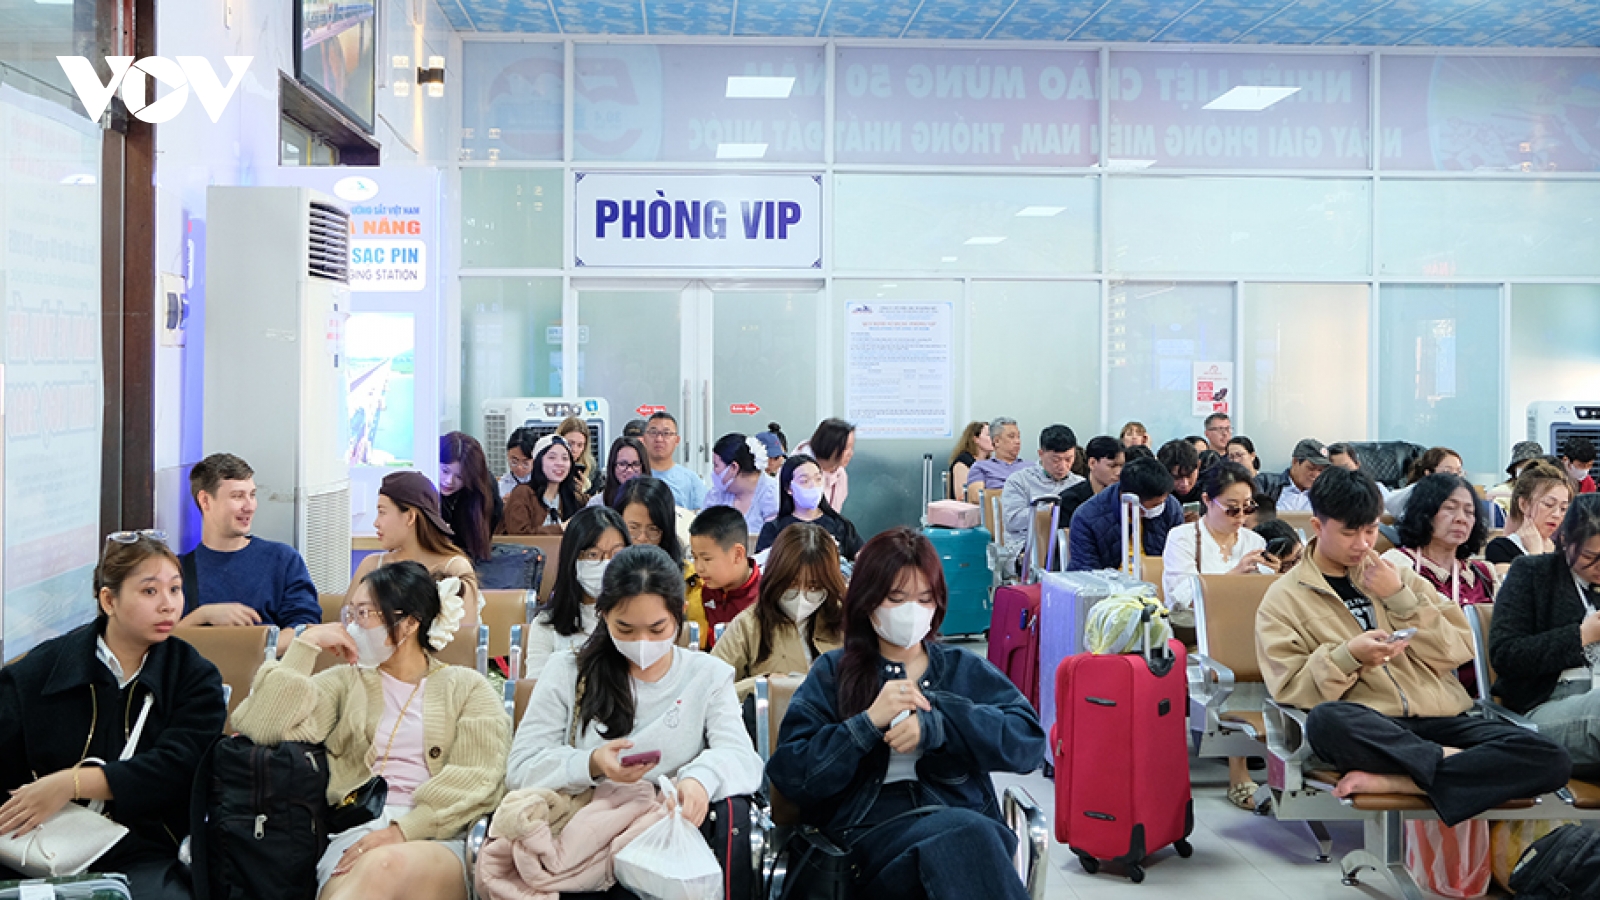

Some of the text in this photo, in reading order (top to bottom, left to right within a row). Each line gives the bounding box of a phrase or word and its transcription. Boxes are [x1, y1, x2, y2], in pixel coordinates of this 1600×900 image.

[351, 205, 372, 214] ƯỜNG
[403, 206, 420, 214] NAM
[595, 189, 802, 240] PHÒNG VIP
[391, 247, 418, 263] PIN
[375, 268, 418, 281] STATION
